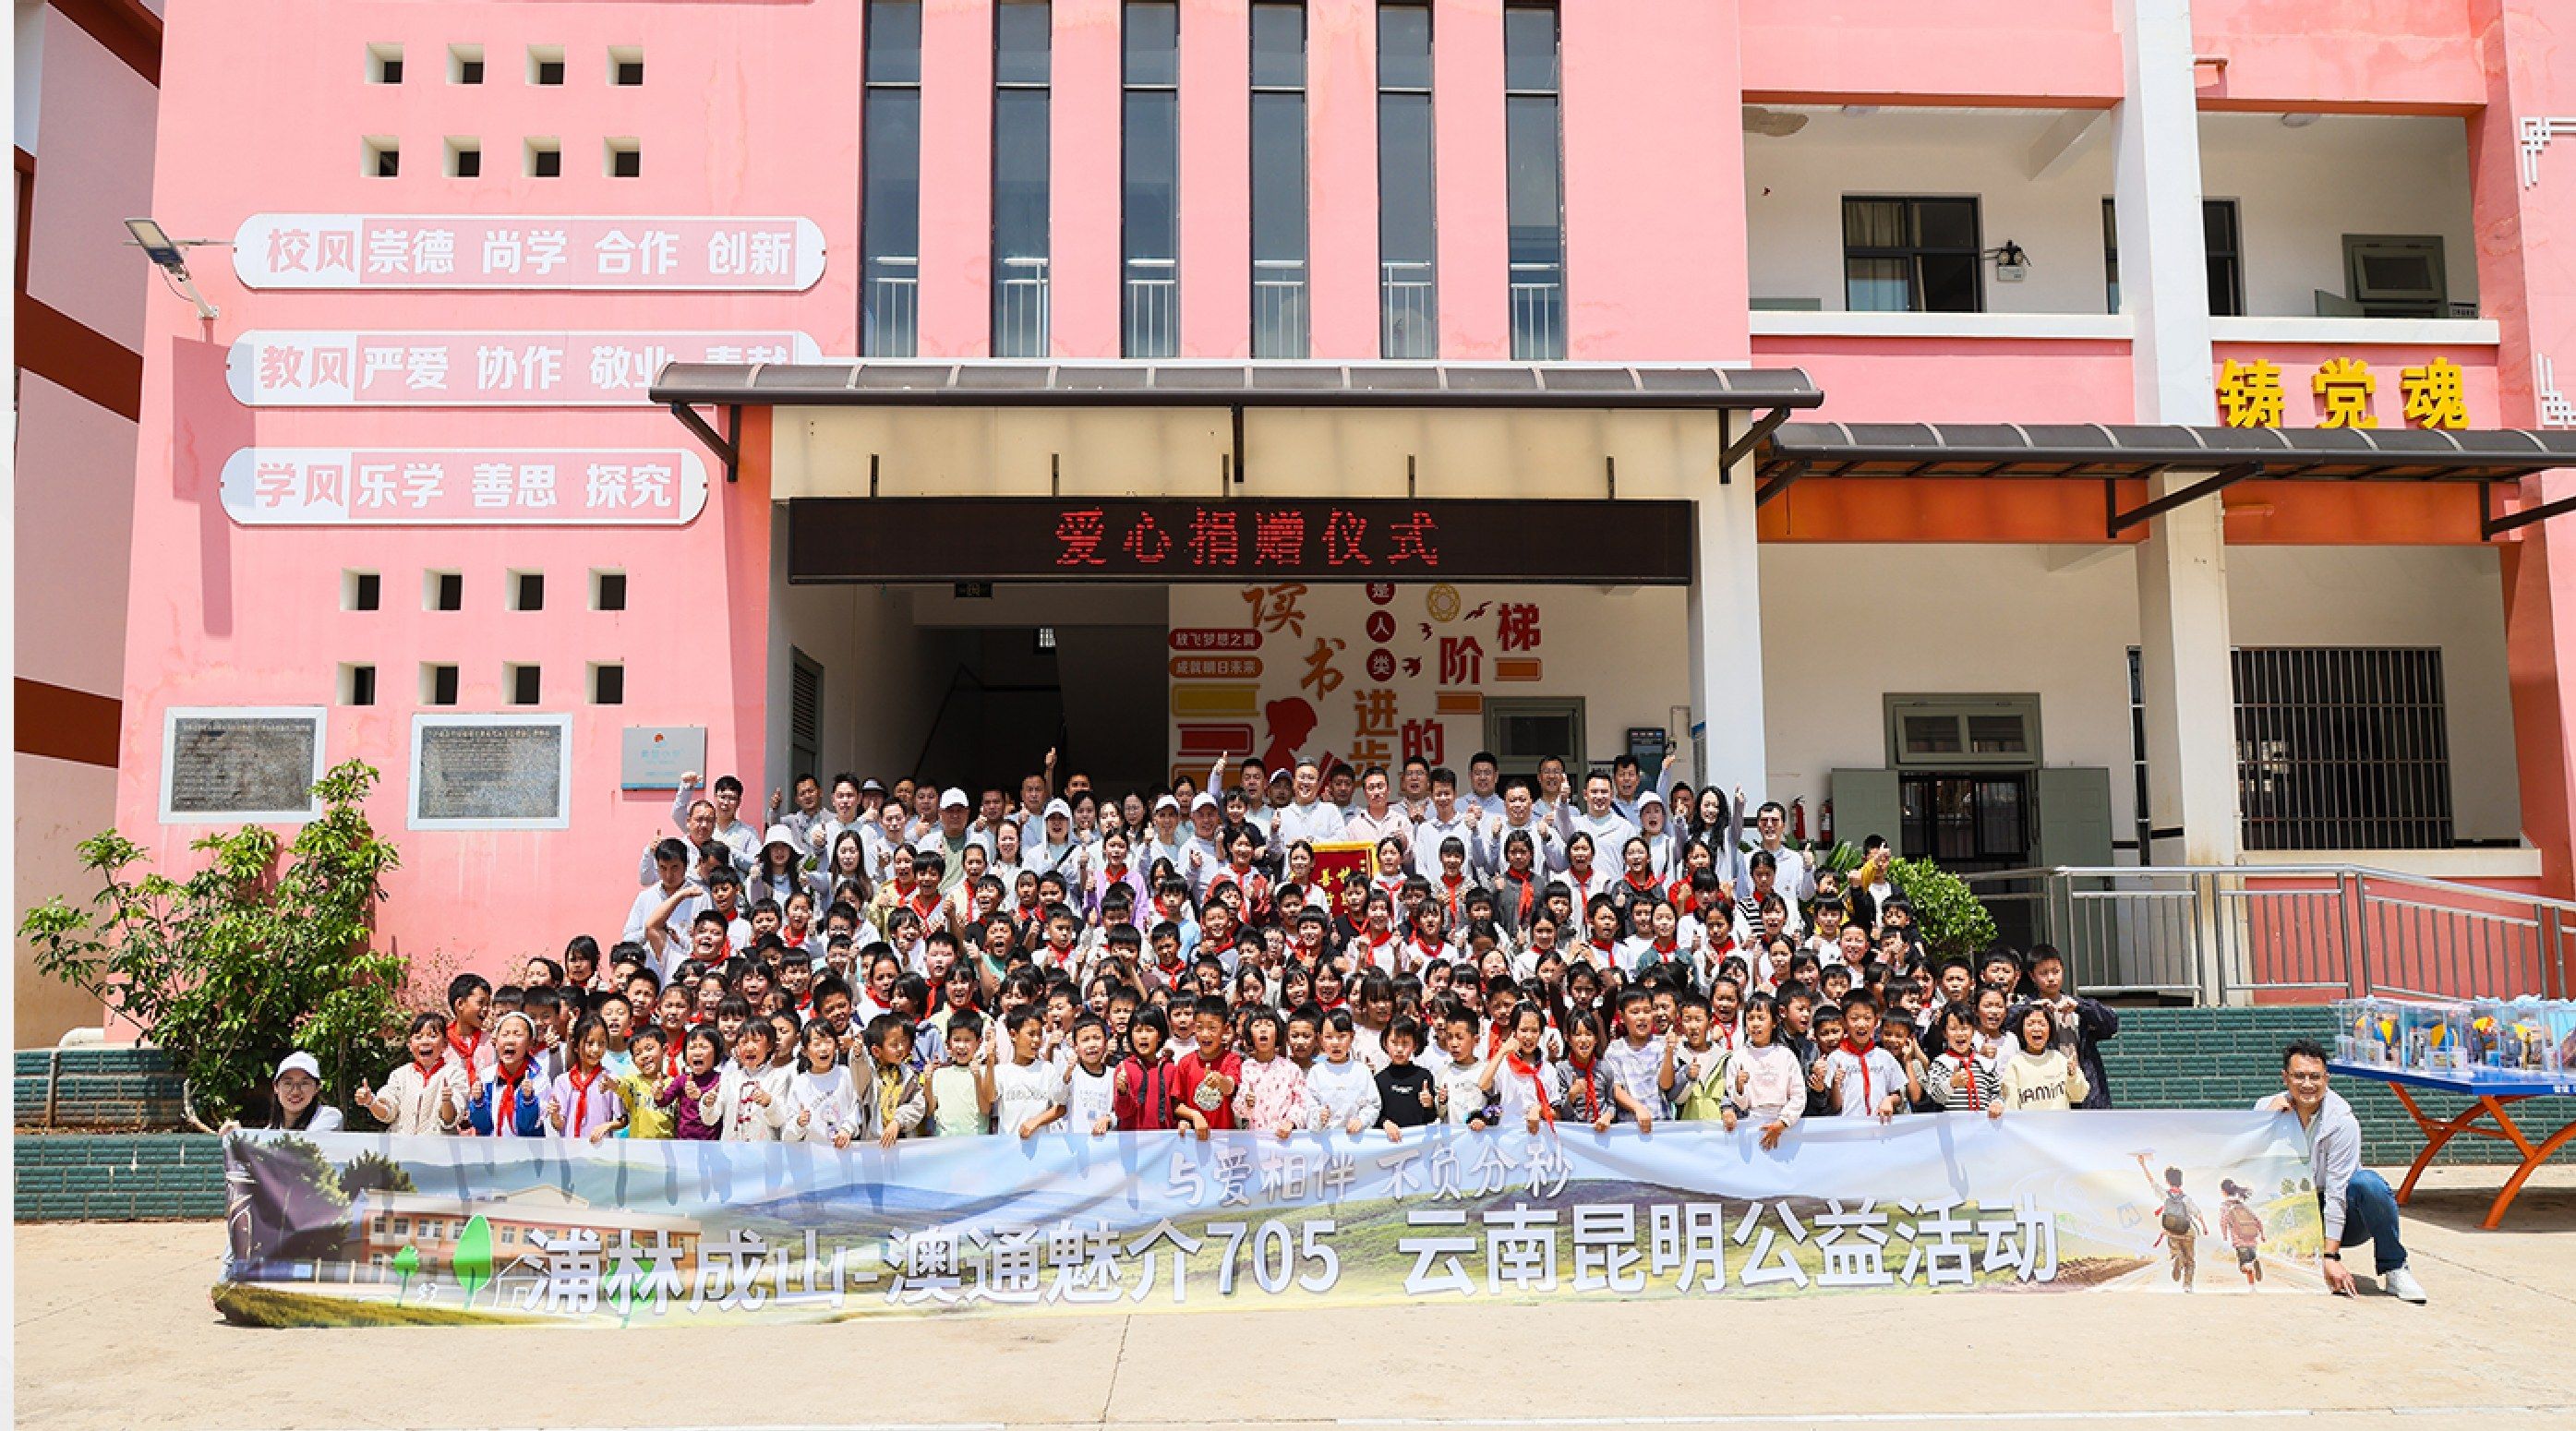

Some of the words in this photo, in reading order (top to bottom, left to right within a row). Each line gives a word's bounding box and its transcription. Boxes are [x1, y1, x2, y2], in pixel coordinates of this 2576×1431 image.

[266, 229, 355, 272] 校风
[368, 229, 455, 273] 崇德
[482, 230, 568, 274] 尚学
[594, 230, 680, 275] 合作
[707, 231, 791, 275] 创新
[259, 345, 349, 389] 教风
[361, 345, 449, 390] 严爱
[476, 345, 564, 390] 协作
[590, 345, 677, 390] 敬业
[2216, 356, 2470, 429] 铸党魂
[255, 463, 344, 508] 学风
[356, 463, 444, 509] 乐学
[471, 463, 558, 509] 善思
[584, 463, 672, 509] 探究
[1054, 506, 1439, 566] 爱心捐赠仪式
[1164, 1147, 1356, 1207] 与爱相伴
[1377, 1141, 1573, 1201] 不负分秒
[527, 1218, 1341, 1316] 浦林成山-澳通魅介705
[1398, 1193, 2058, 1294] 云南昆明公益活动
